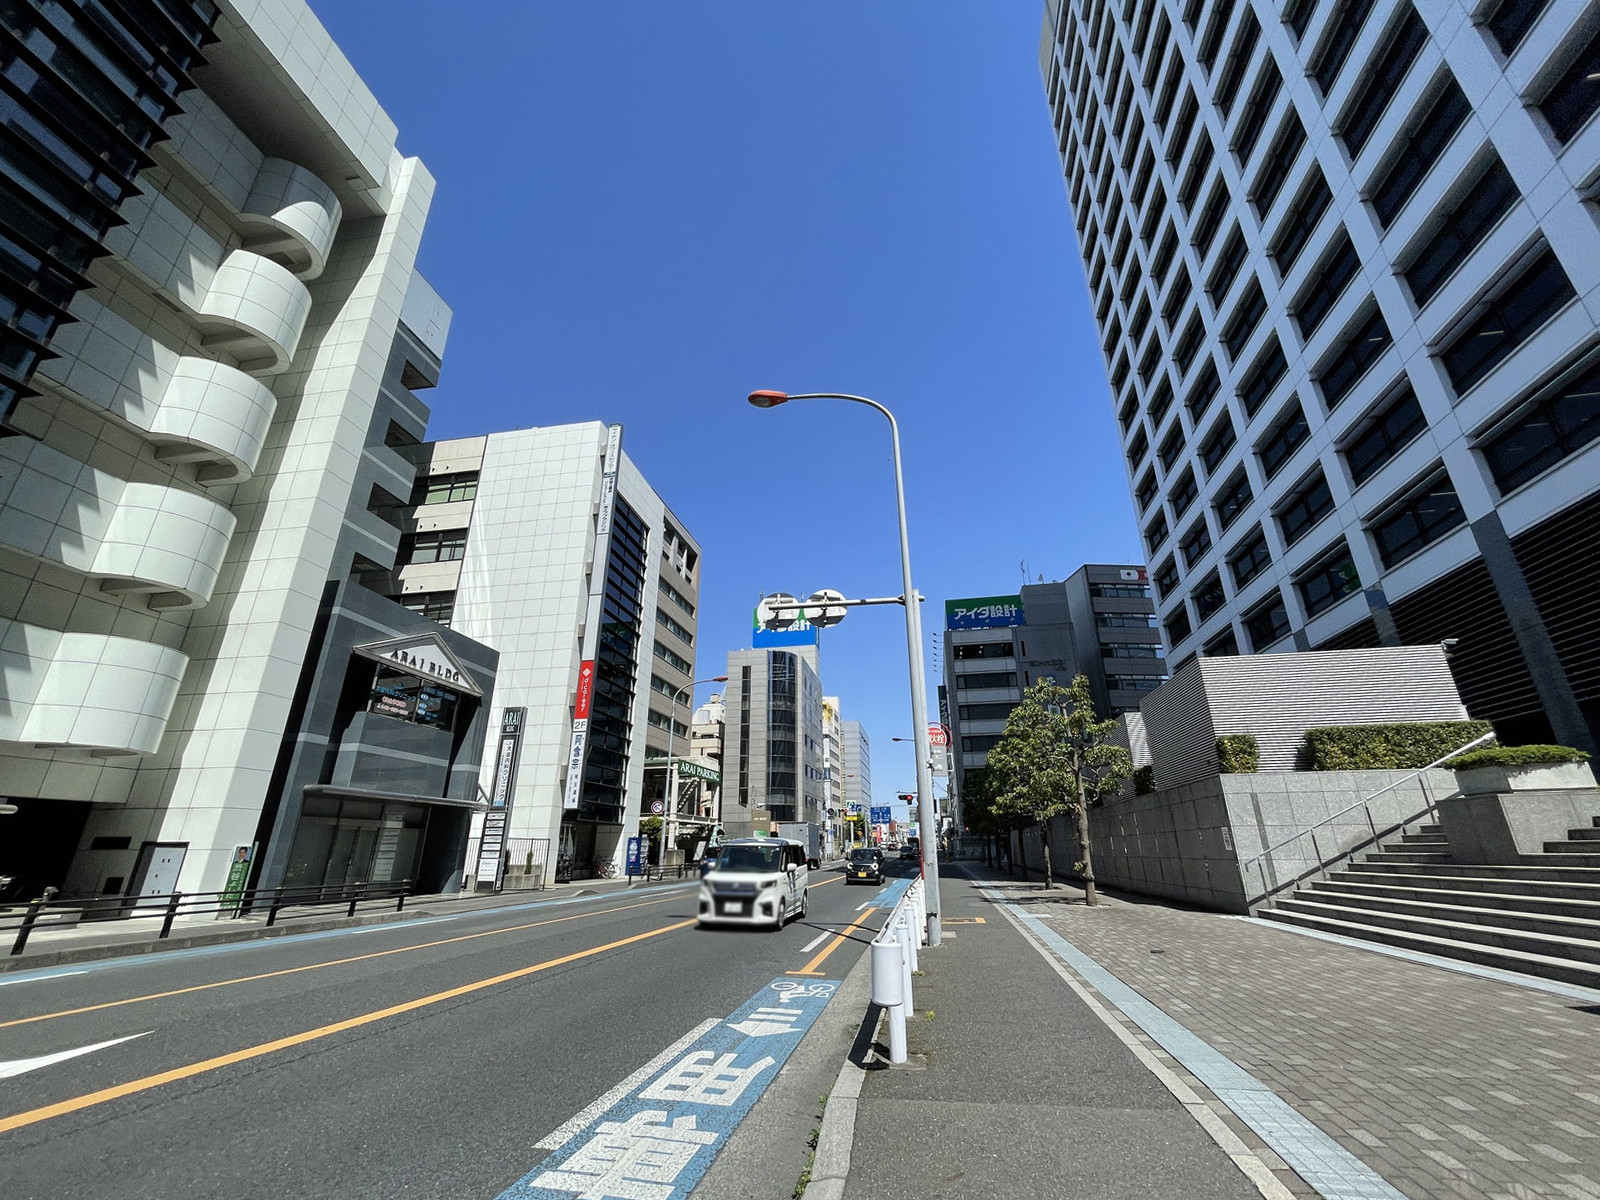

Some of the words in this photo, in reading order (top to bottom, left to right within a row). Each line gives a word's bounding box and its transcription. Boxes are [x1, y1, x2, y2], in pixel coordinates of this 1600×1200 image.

[954, 604, 1018, 620] アイダ設計
[390, 648, 425, 670] ARAI
[429, 661, 460, 681] BLDG
[503, 711, 520, 726] ARAI
[574, 721, 587, 730] 2F
[680, 761, 697, 775] ARAI
[696, 767, 720, 782] PARKING
